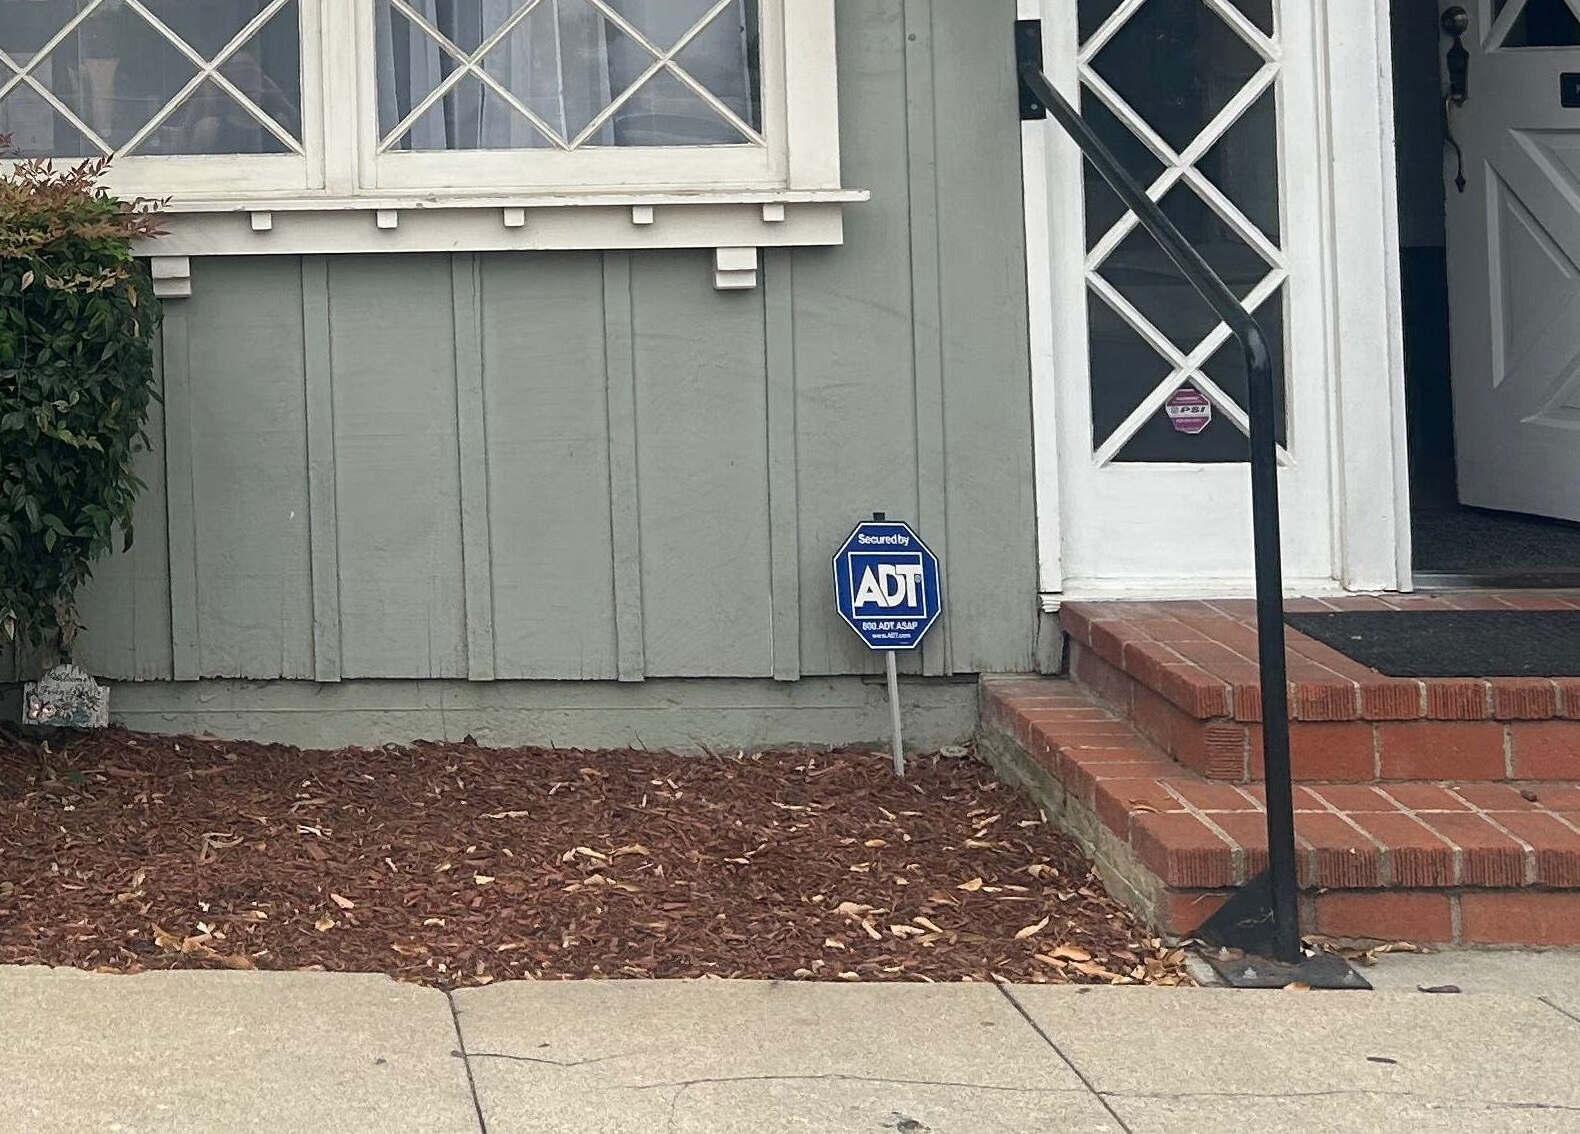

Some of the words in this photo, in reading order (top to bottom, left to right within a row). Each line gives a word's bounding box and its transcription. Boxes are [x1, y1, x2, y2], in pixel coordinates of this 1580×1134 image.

[858, 534, 897, 544] Secured
[898, 534, 909, 546] by
[854, 564, 922, 607] ADT
